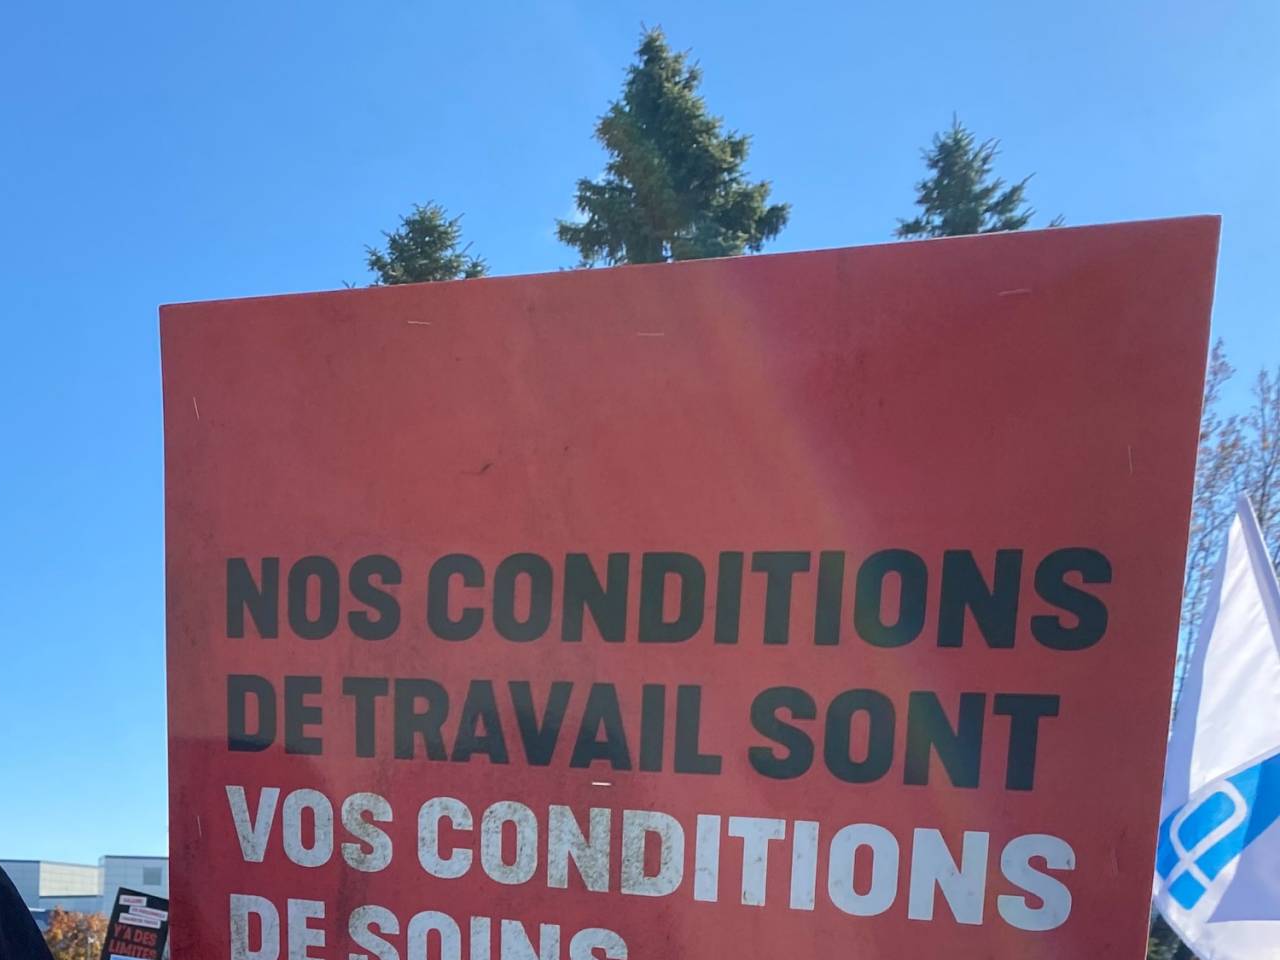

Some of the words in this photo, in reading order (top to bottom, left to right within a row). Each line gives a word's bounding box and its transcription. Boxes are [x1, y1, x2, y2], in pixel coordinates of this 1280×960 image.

[226, 554, 402, 641] NOS
[426, 547, 1113, 651] CONDITIONS
[226, 674, 323, 755] DE
[342, 676, 722, 775] TRAVAIL
[748, 686, 1060, 791] SONT
[225, 785, 393, 872] VOS
[417, 797, 1076, 931] CONDITIONS
[109, 940, 157, 959] LIMITES
[133, 929, 157, 946] DES
